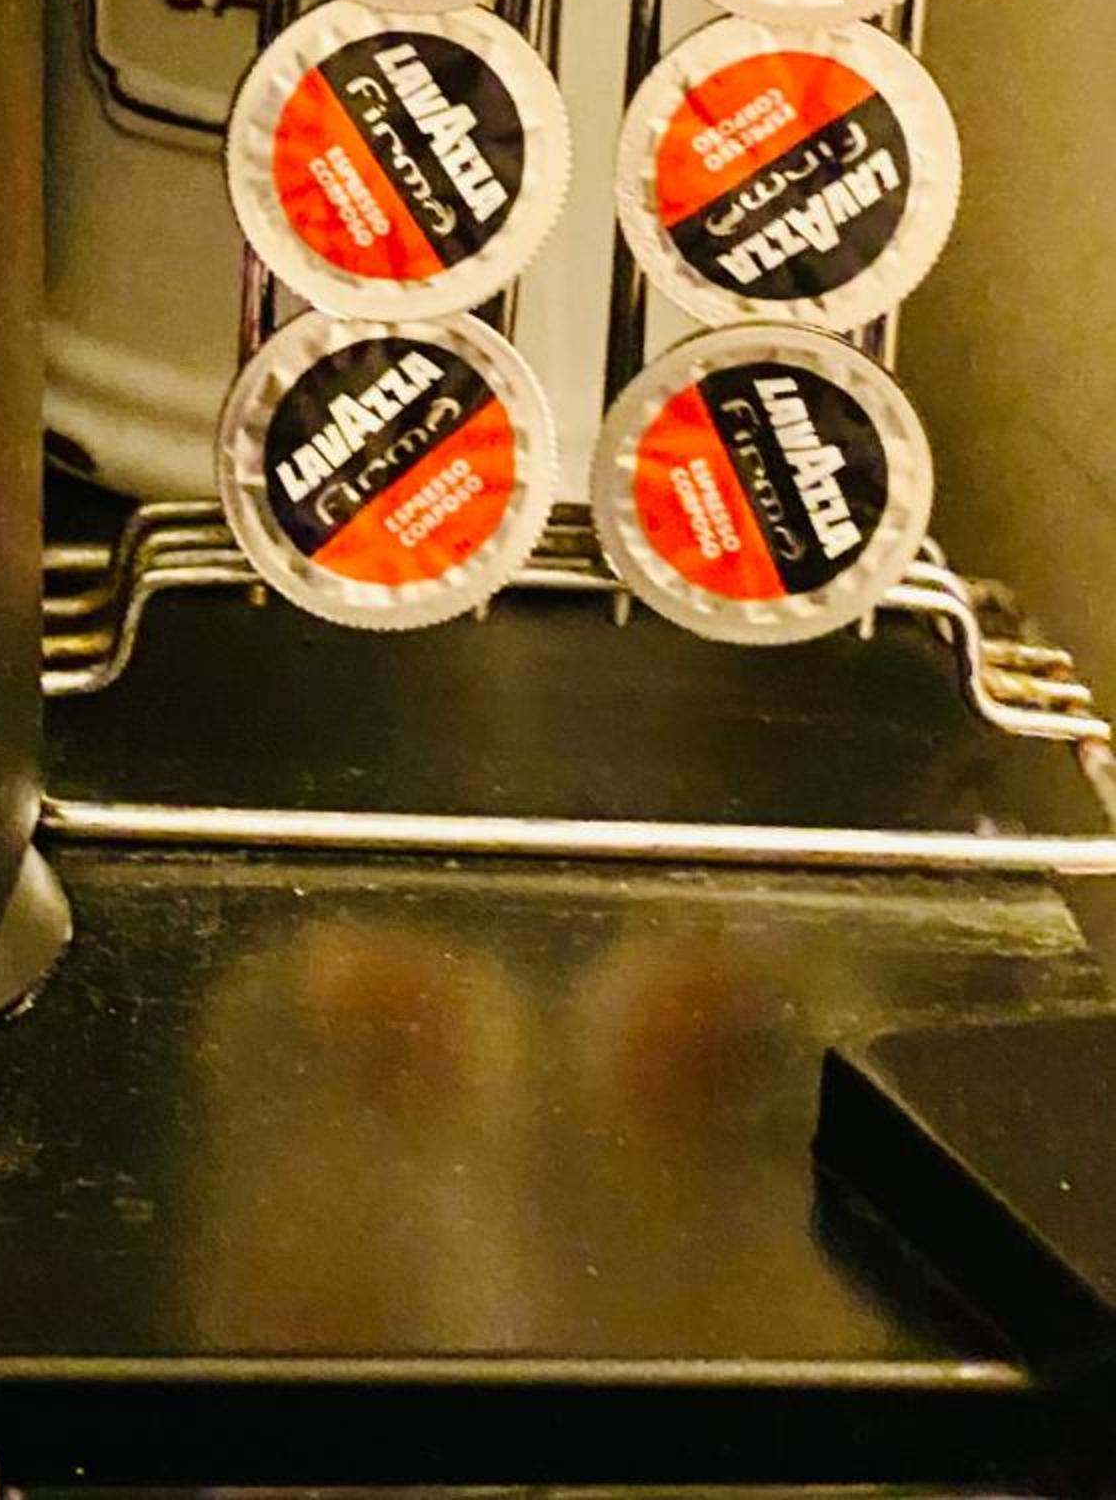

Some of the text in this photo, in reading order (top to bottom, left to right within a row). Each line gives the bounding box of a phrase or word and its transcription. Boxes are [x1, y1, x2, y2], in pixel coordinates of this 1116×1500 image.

[373, 43, 509, 223] LAVAZZA
[716, 148, 901, 285] LAVAZZA
[275, 351, 445, 502] LAVAZZA
[753, 376, 862, 560] LAVAZZA
